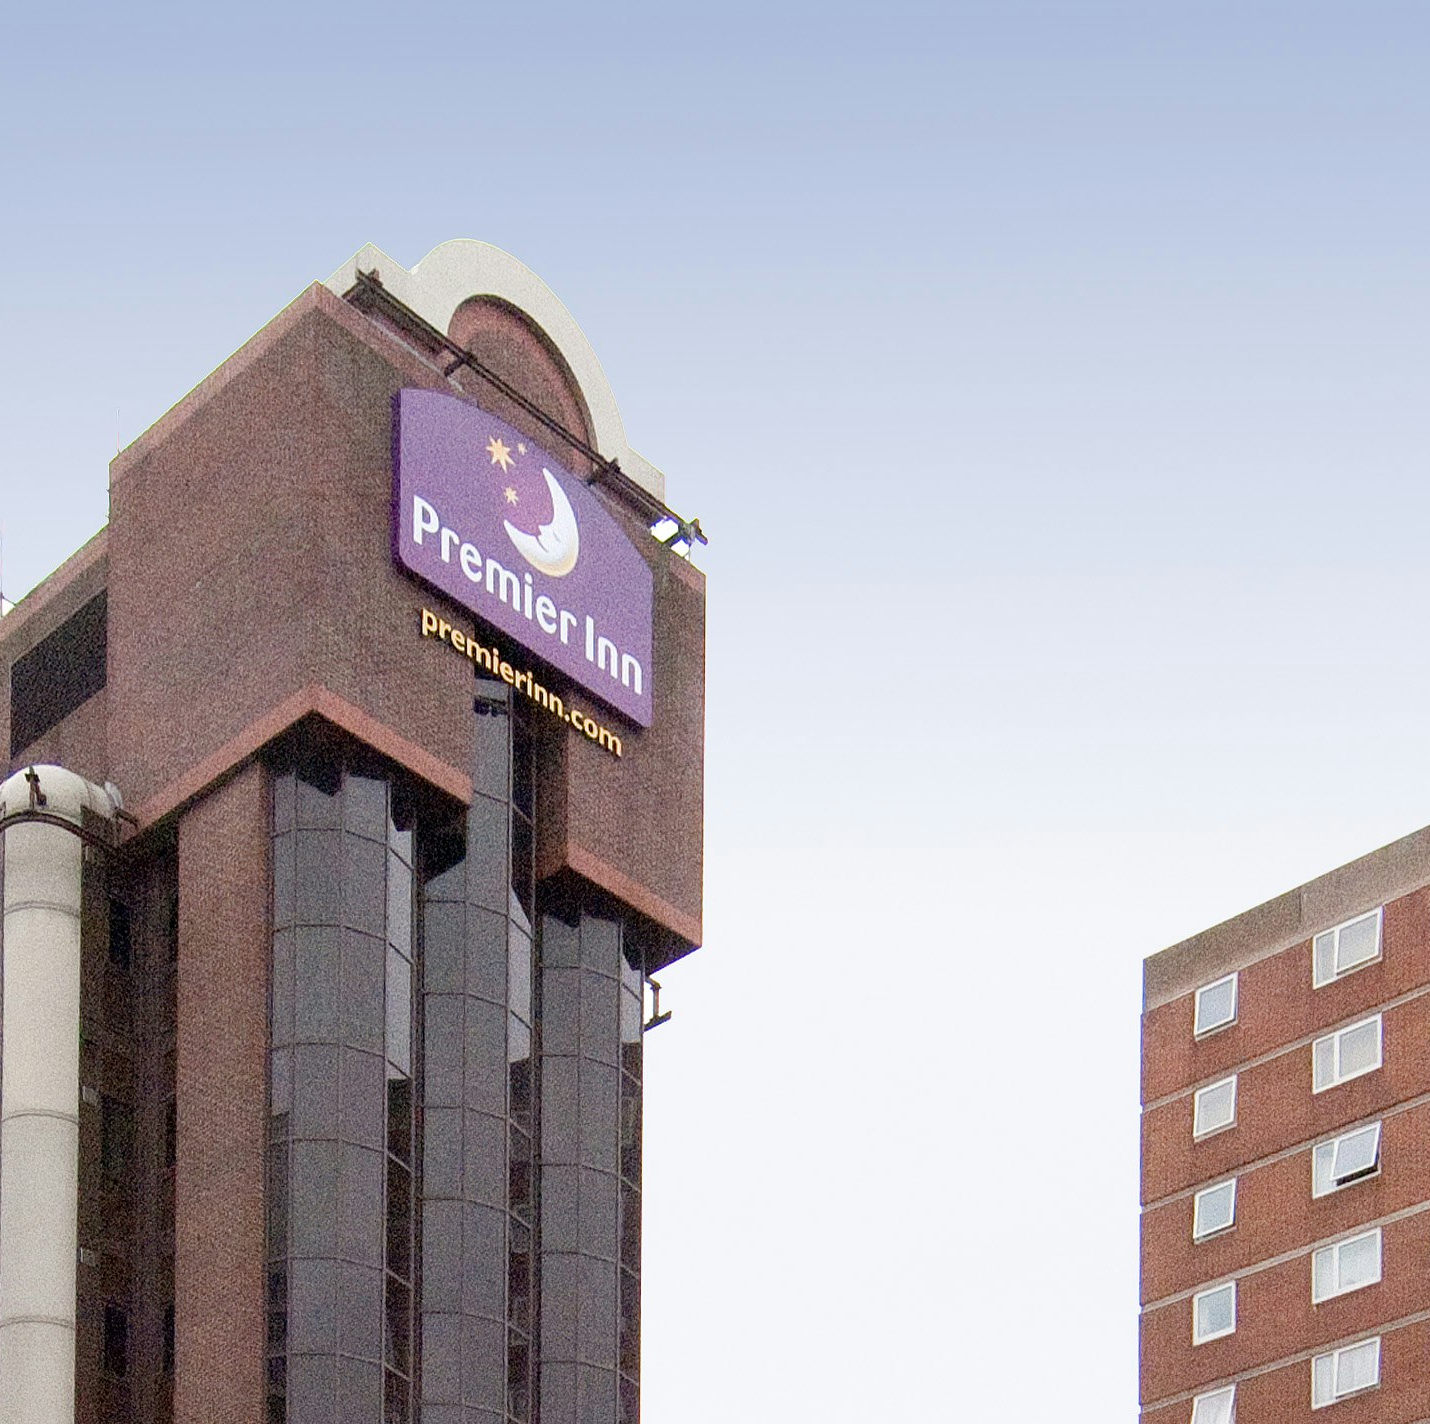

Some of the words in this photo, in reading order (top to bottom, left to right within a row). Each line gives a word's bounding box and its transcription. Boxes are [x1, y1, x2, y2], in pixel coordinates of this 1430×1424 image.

[412, 494, 577, 645] Premier
[585, 614, 643, 695] Inn
[421, 608, 622, 758] premierinn.com
